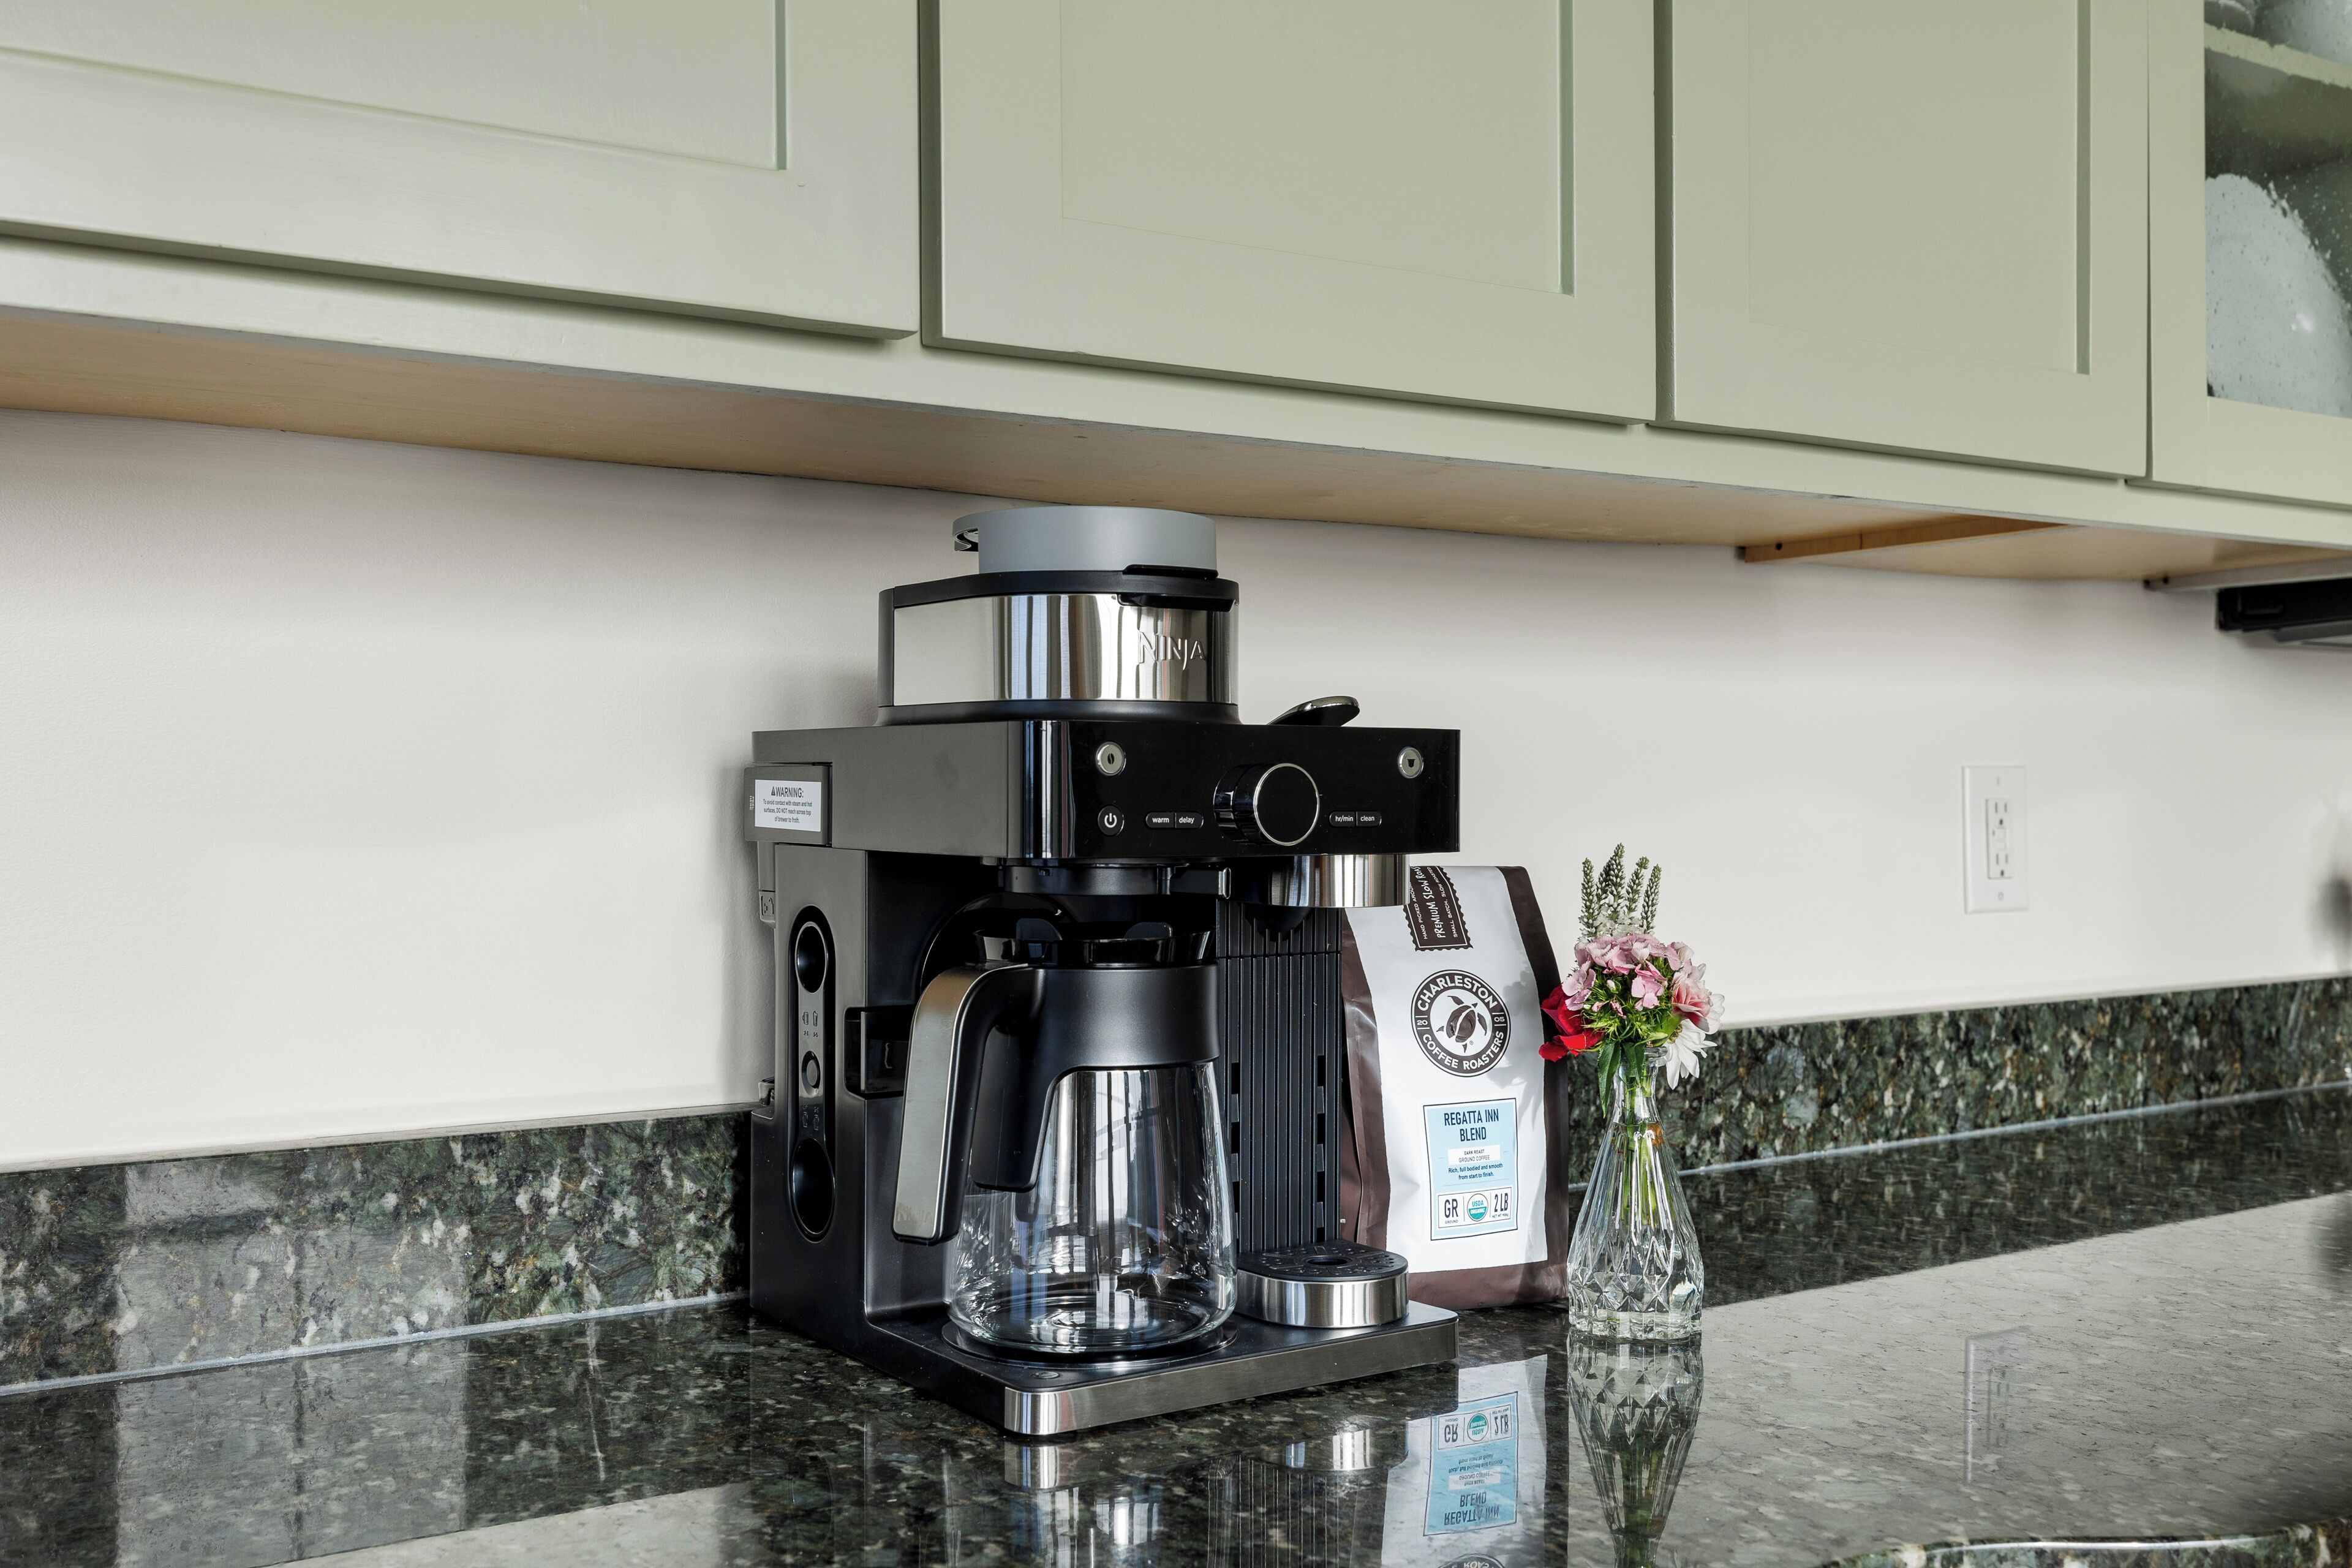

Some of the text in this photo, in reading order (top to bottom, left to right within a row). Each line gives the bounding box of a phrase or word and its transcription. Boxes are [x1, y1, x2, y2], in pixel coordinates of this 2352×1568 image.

[1138, 631, 1205, 670] NINJA
[775, 787, 804, 798] WARNING:
[1427, 867, 1440, 883] ROASTED
[1418, 880, 1434, 899] SLOW
[1414, 903, 1423, 923] PICKED
[1426, 902, 1446, 938] PREMIUM
[1417, 975, 1498, 1011] CHARLESTON
[1423, 1031, 1504, 1070] COFFEE ROASTERS
[1444, 1109, 1499, 1126] REGATTA INN
[1460, 1126, 1487, 1142] BLEND
[1444, 1199, 1458, 1218] GR
[1494, 1193, 1509, 1212] 2 LB
